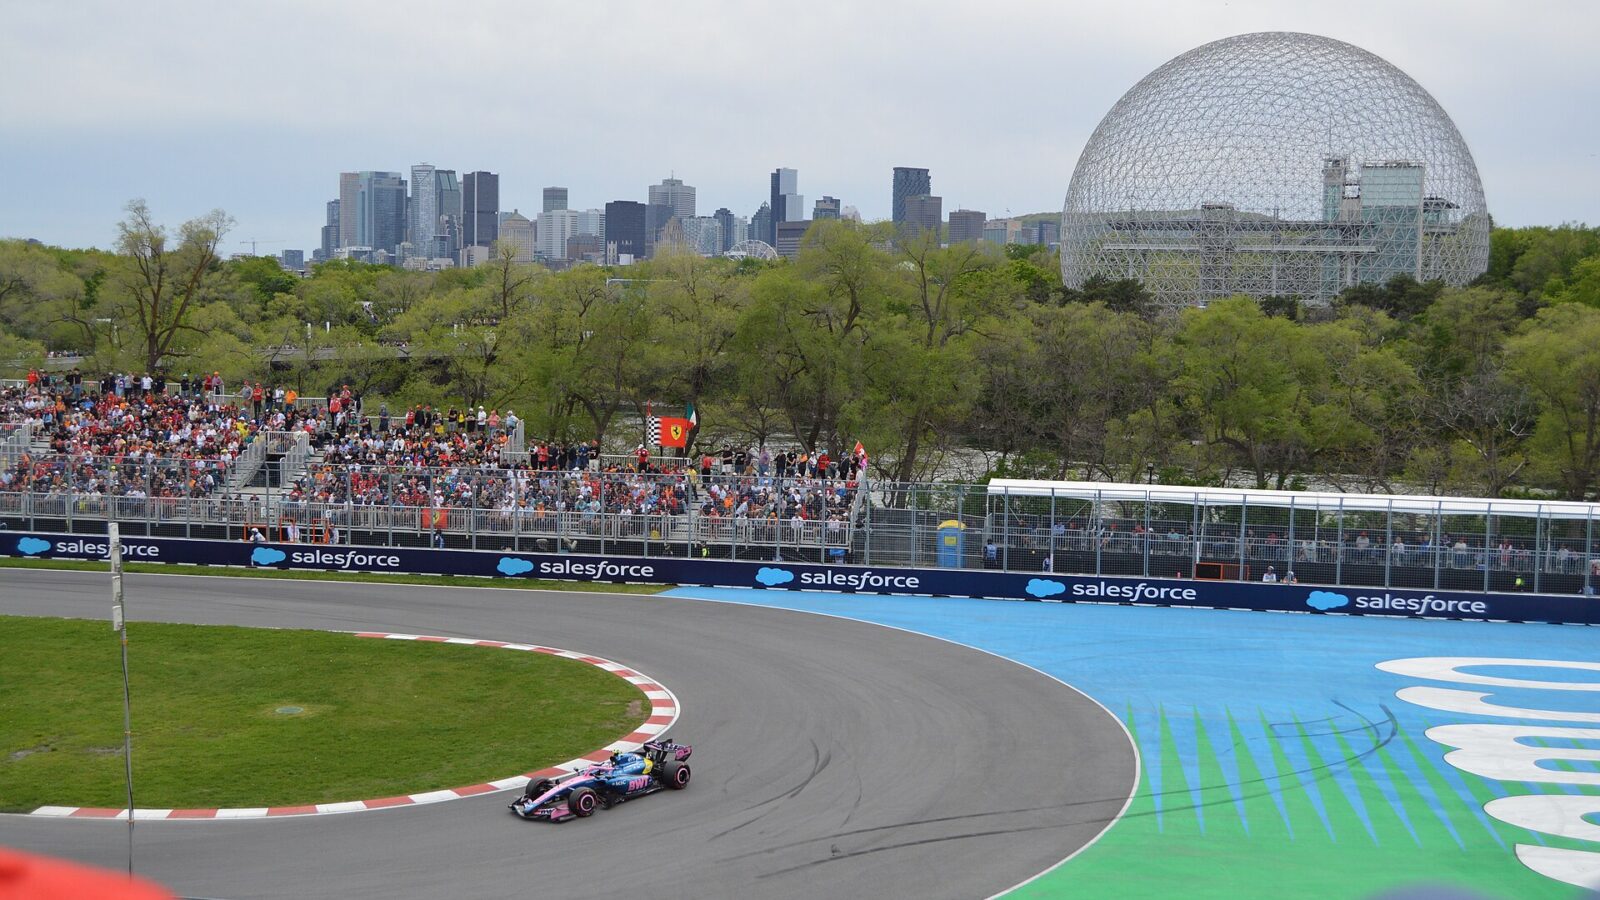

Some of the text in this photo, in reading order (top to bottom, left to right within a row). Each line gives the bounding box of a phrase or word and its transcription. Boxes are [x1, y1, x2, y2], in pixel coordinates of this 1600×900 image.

[292, 549, 400, 569] salesforce
[540, 559, 654, 579] salesforce
[800, 569, 920, 590] salesforce
[1072, 581, 1197, 602] salesforce
[1355, 593, 1486, 615] salesforce
[627, 775, 651, 791] BWT
